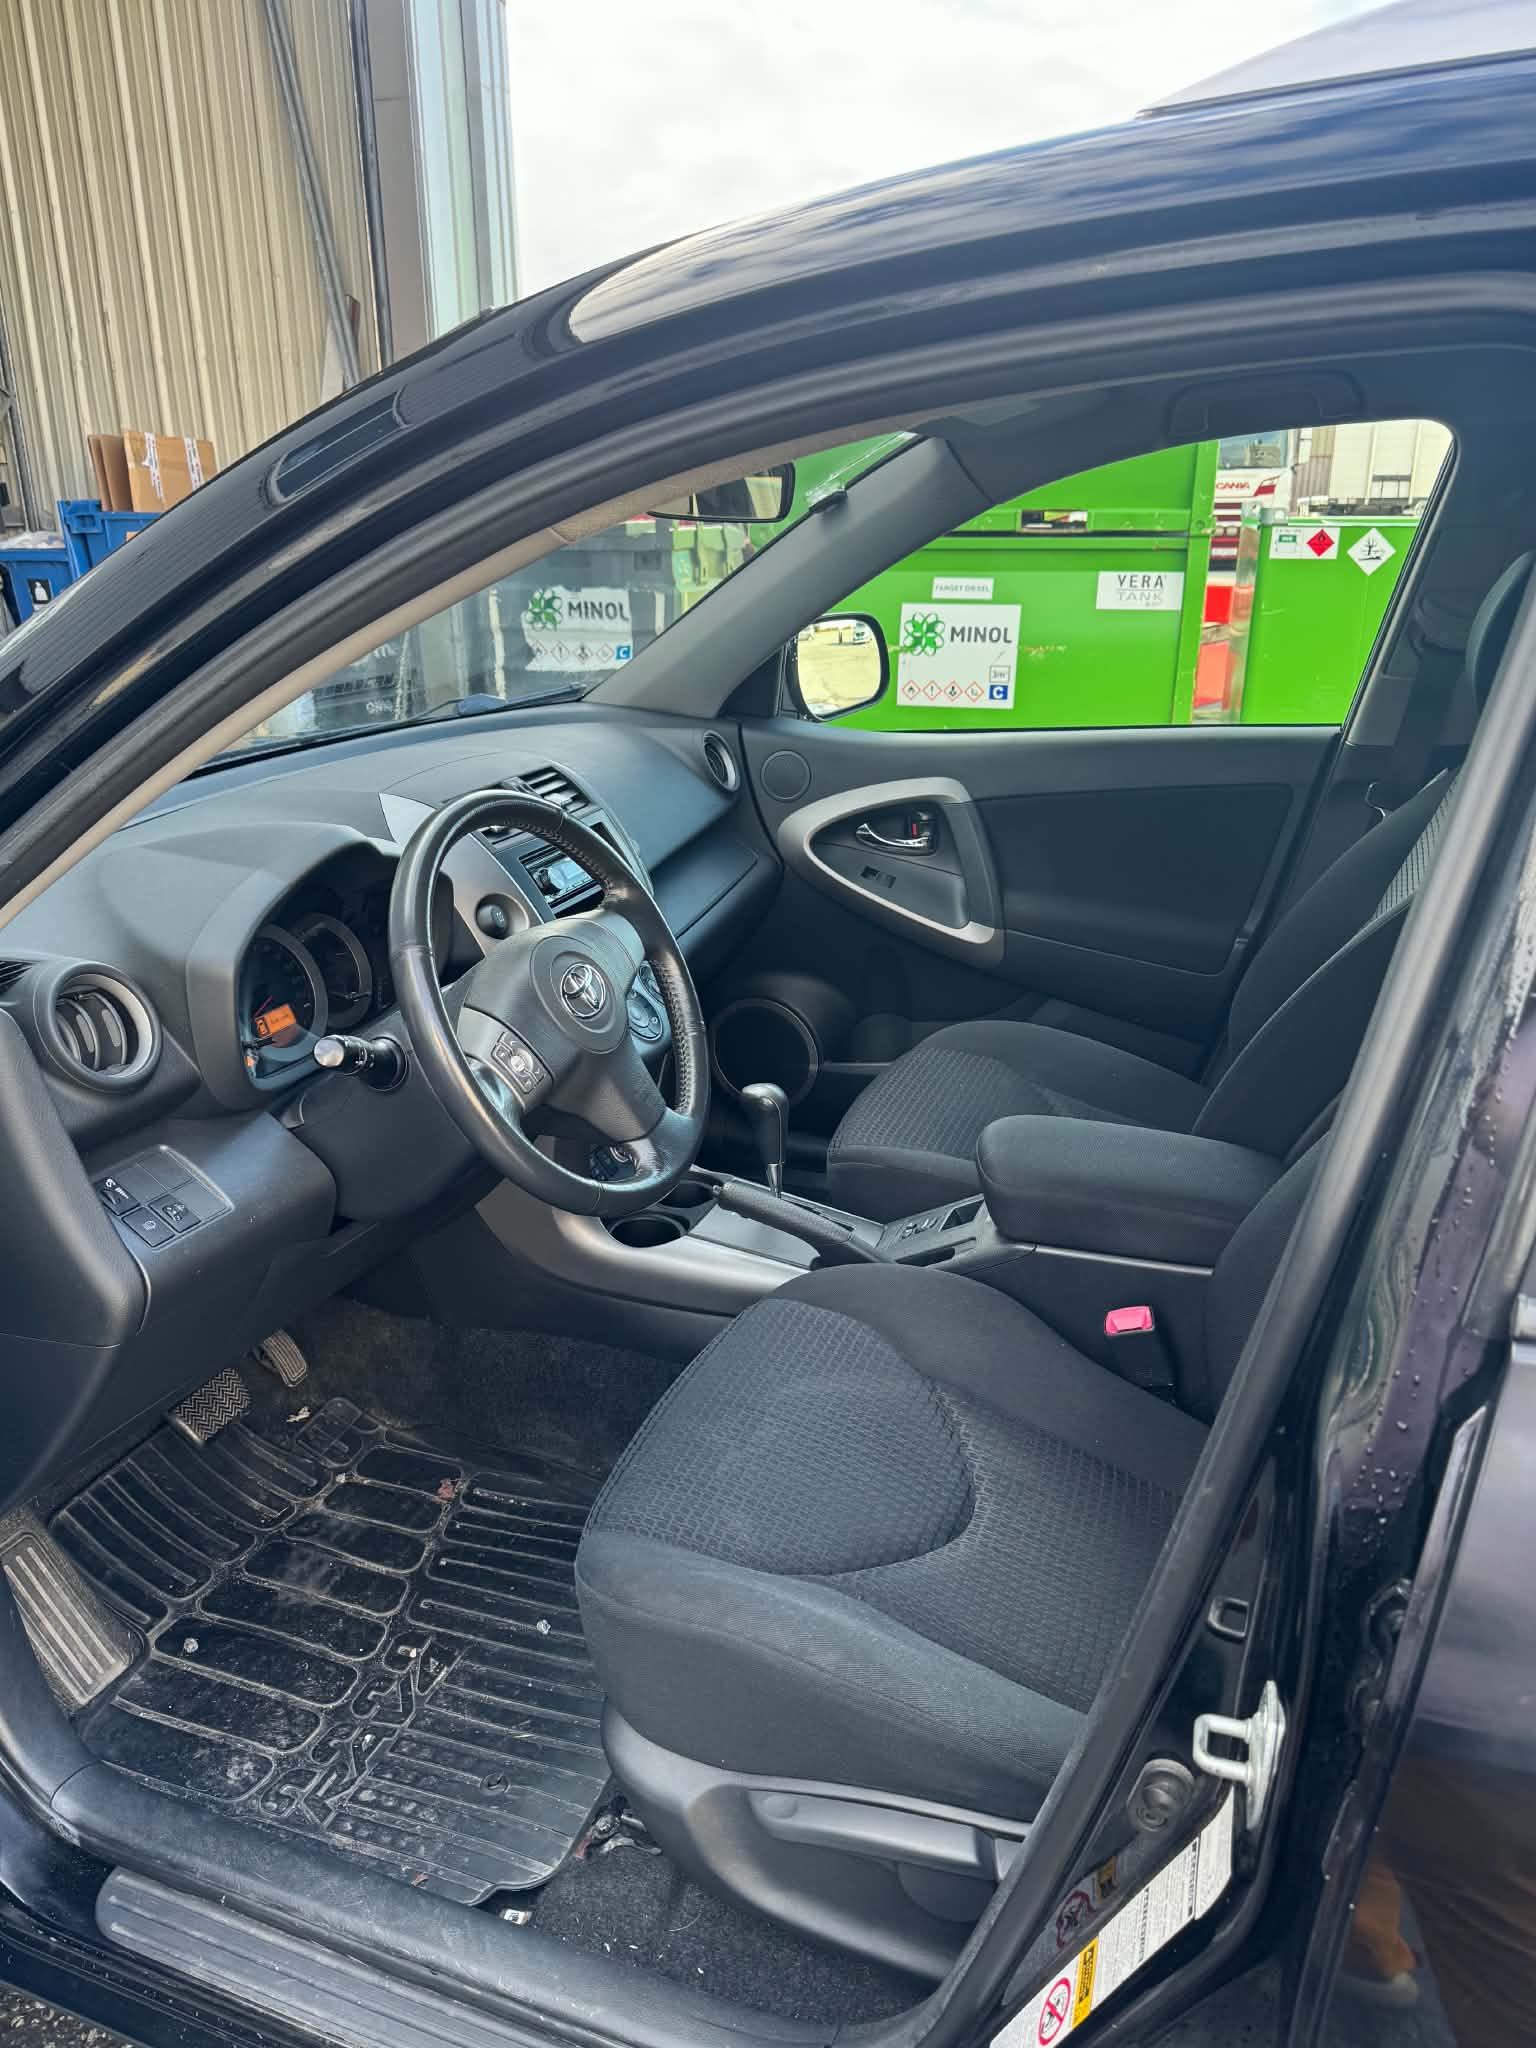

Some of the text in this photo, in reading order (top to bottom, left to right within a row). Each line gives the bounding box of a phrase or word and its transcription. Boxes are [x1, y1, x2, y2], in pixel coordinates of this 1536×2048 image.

[1216, 482, 1250, 490] CANIA
[1117, 574, 1164, 588] VERA
[567, 601, 629, 621] MINOL
[950, 626, 1013, 644] MINOL
[992, 686, 1004, 699] C
